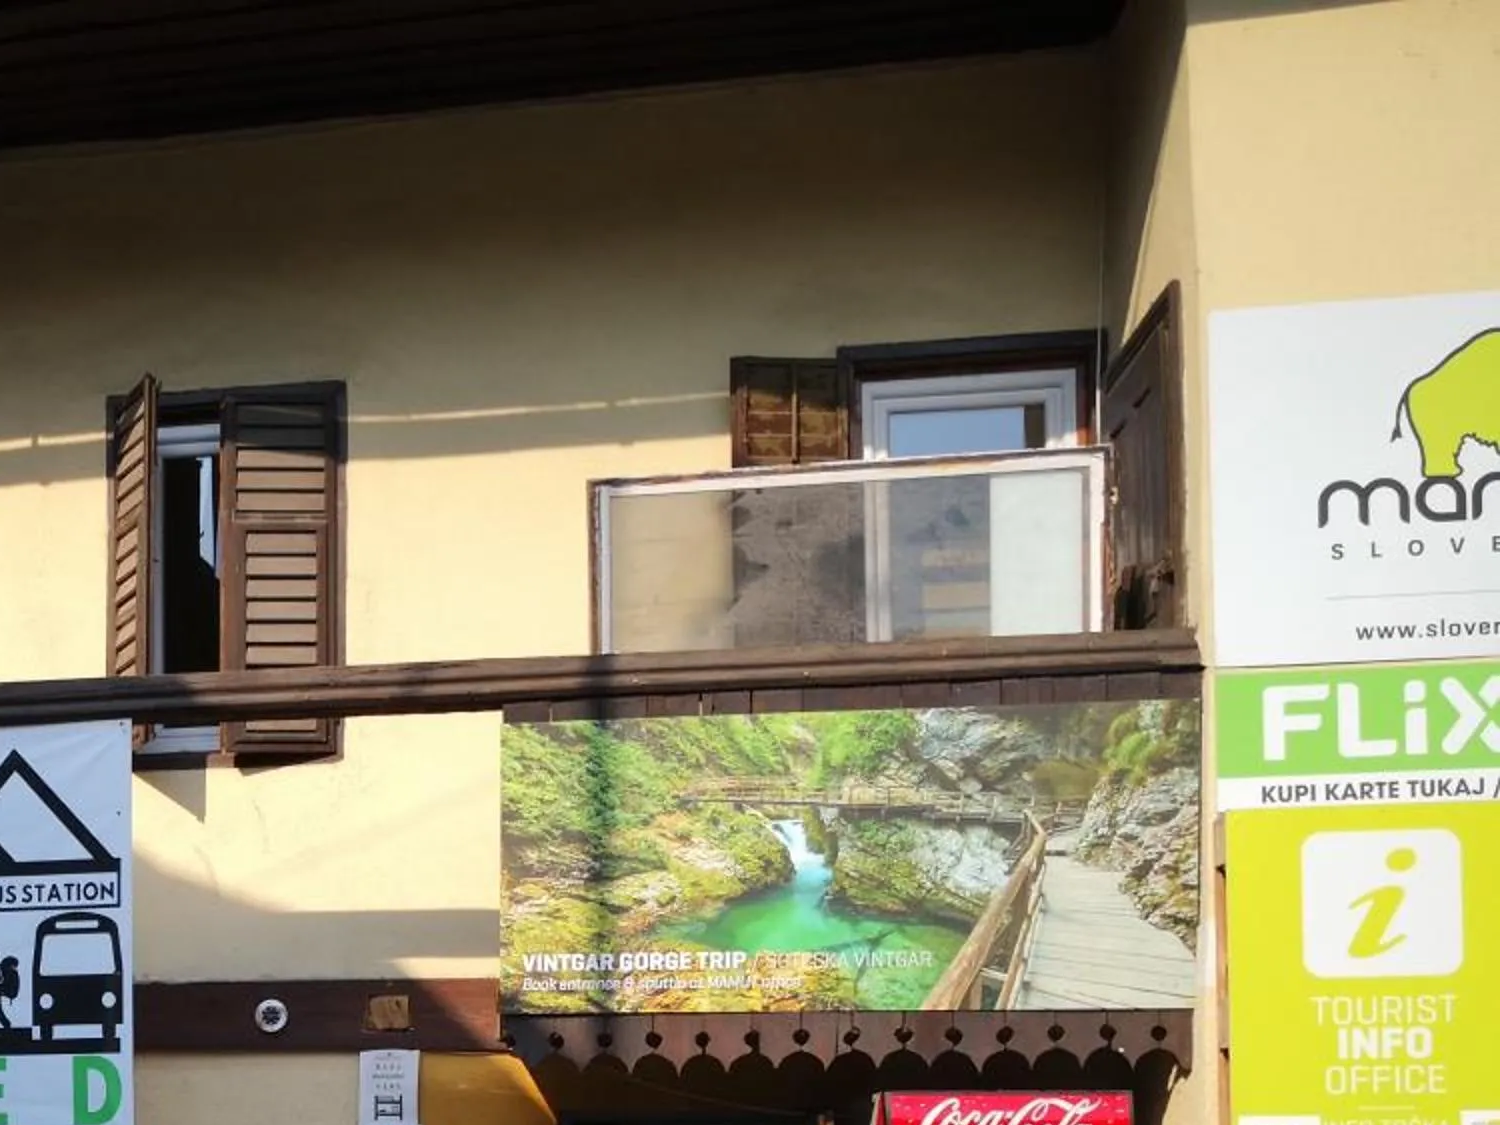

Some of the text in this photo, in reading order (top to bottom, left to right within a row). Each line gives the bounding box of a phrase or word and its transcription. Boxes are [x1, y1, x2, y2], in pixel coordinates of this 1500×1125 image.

[1261, 784, 1317, 804] KUPI
[1325, 781, 1400, 801] KARTE
[1407, 777, 1486, 798] TUKAJ
[22, 882, 116, 904] STATION
[523, 953, 616, 973] VINTGAR
[620, 952, 692, 972] GORGE
[695, 951, 747, 970] TRIP
[852, 950, 933, 968] VINTGAR
[523, 977, 557, 992] Book
[1310, 994, 1458, 1027] TOURIST
[1338, 1026, 1434, 1060] INFO
[1325, 1064, 1446, 1095] OFFICE
